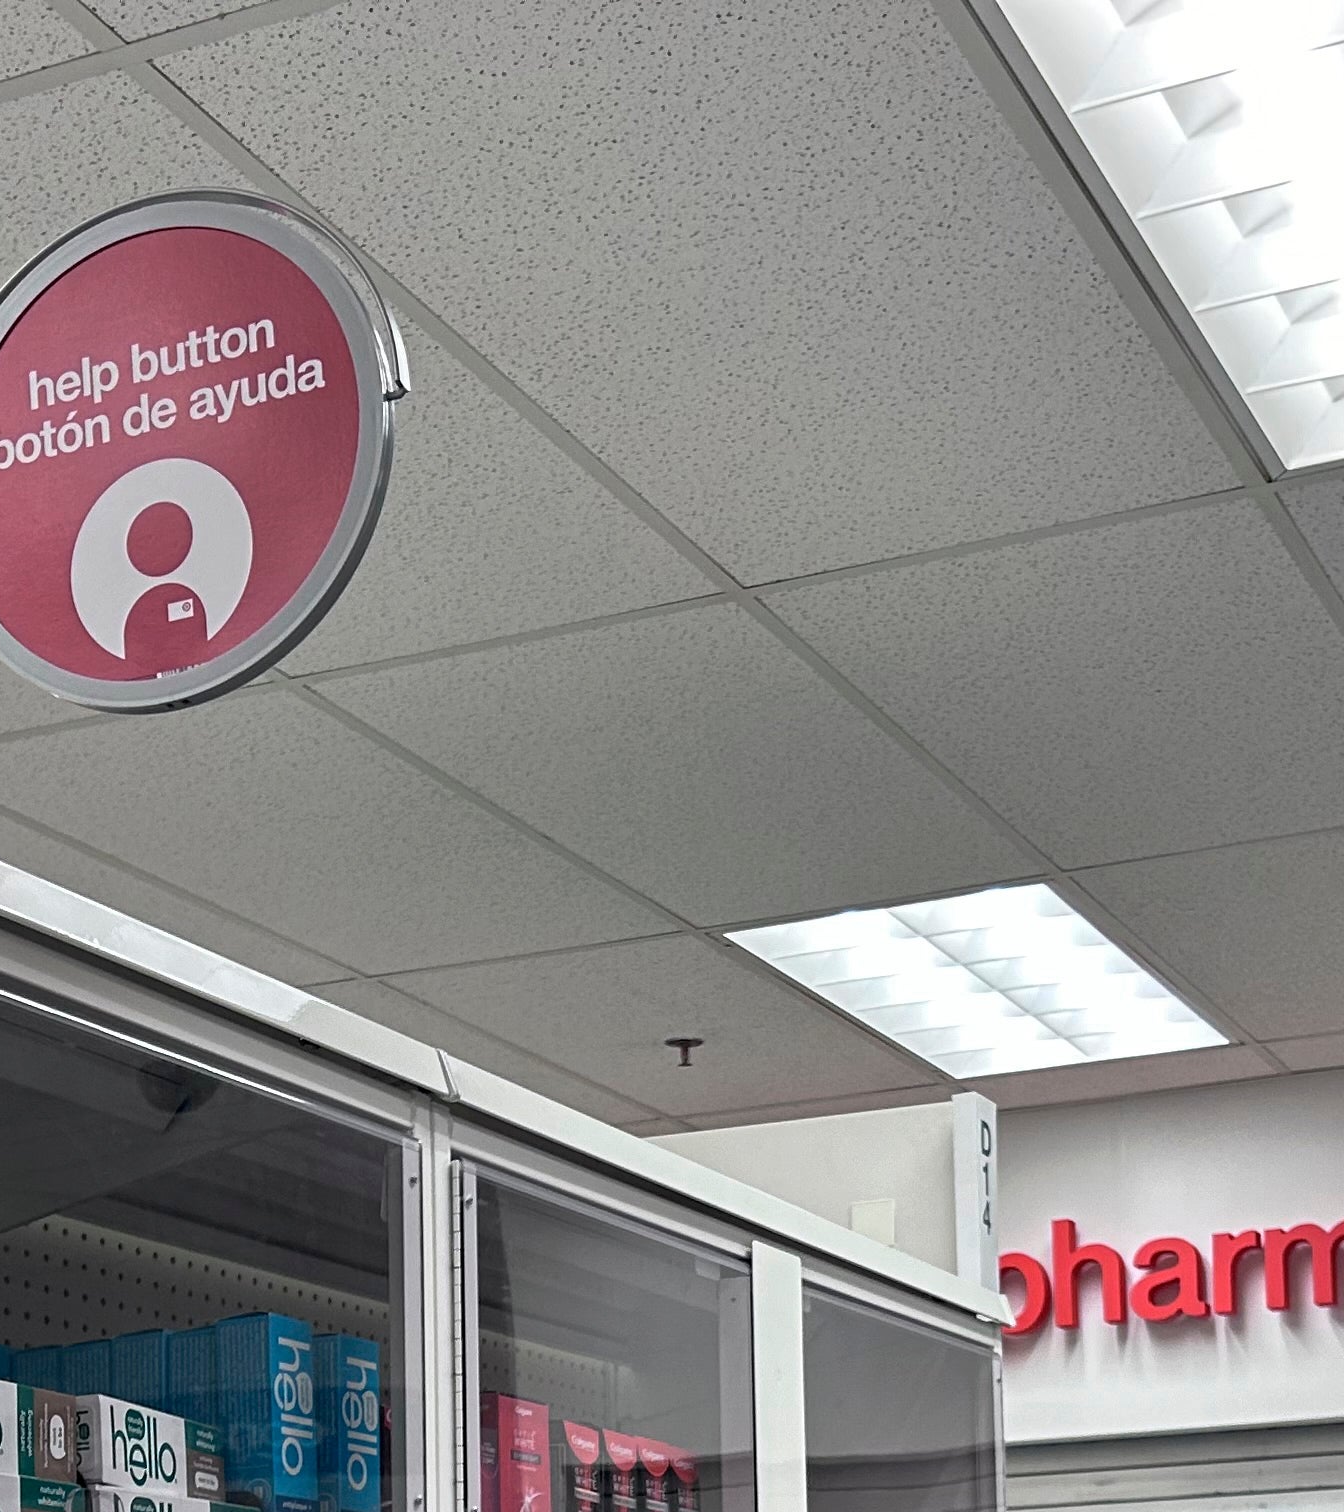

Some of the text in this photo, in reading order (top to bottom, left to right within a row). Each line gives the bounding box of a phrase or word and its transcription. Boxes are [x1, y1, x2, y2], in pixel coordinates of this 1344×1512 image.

[29, 319, 275, 410] help button
[123, 393, 177, 437] de
[189, 355, 325, 423] ayuda
[110, 1405, 177, 1486] hello
[274, 1337, 313, 1476] hello
[342, 1357, 378, 1491] hello
